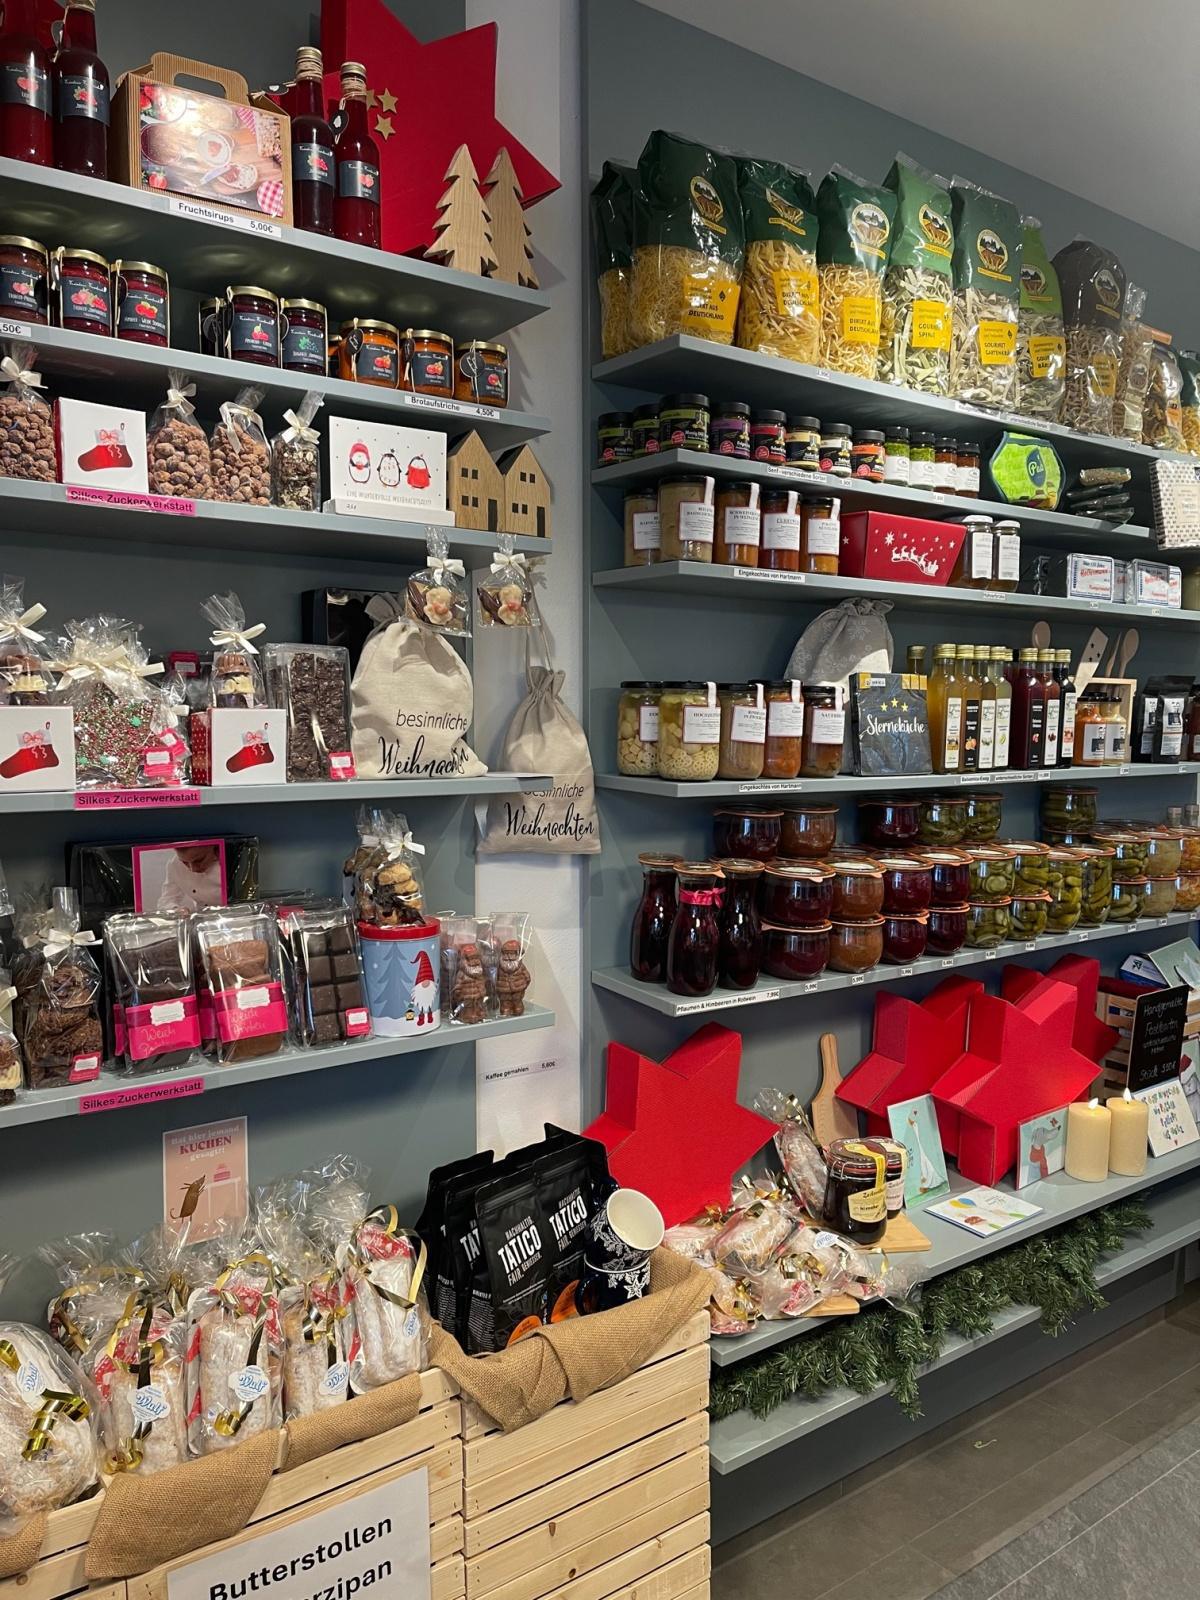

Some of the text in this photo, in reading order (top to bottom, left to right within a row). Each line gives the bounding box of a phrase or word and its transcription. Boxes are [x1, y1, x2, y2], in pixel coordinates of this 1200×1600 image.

[178, 202, 273, 233] Fruchtsirups 5,00€
[411, 396, 495, 418] Brotaufstriche 4,50€
[738, 569, 770, 579] Eingekochtes
[779, 572, 802, 581] Hartmann
[396, 709, 467, 731] besinnliche
[864, 713, 926, 736] Sterneküche
[78, 792, 199, 806] Silkes Zuckerwerkstatt
[503, 802, 595, 841] Weihnachten
[485, 1072, 503, 1081] Kaffee
[503, 1066, 529, 1078] gemahlen
[82, 1081, 202, 1110] Silkes Zuckerwerkstatt
[180, 1135, 232, 1155] KUCHEN
[548, 1195, 588, 1240] TATICO
[460, 1227, 480, 1262] TAT
[497, 1224, 542, 1275] TATICO
[557, 1239, 572, 1252] FAIR.
[507, 1264, 525, 1287] FAIR.
[238, 1376, 268, 1392] Wulf
[326, 1364, 349, 1388] Wul
[135, 1394, 168, 1415] Wulf
[208, 1518, 392, 1600] Butterstollen
